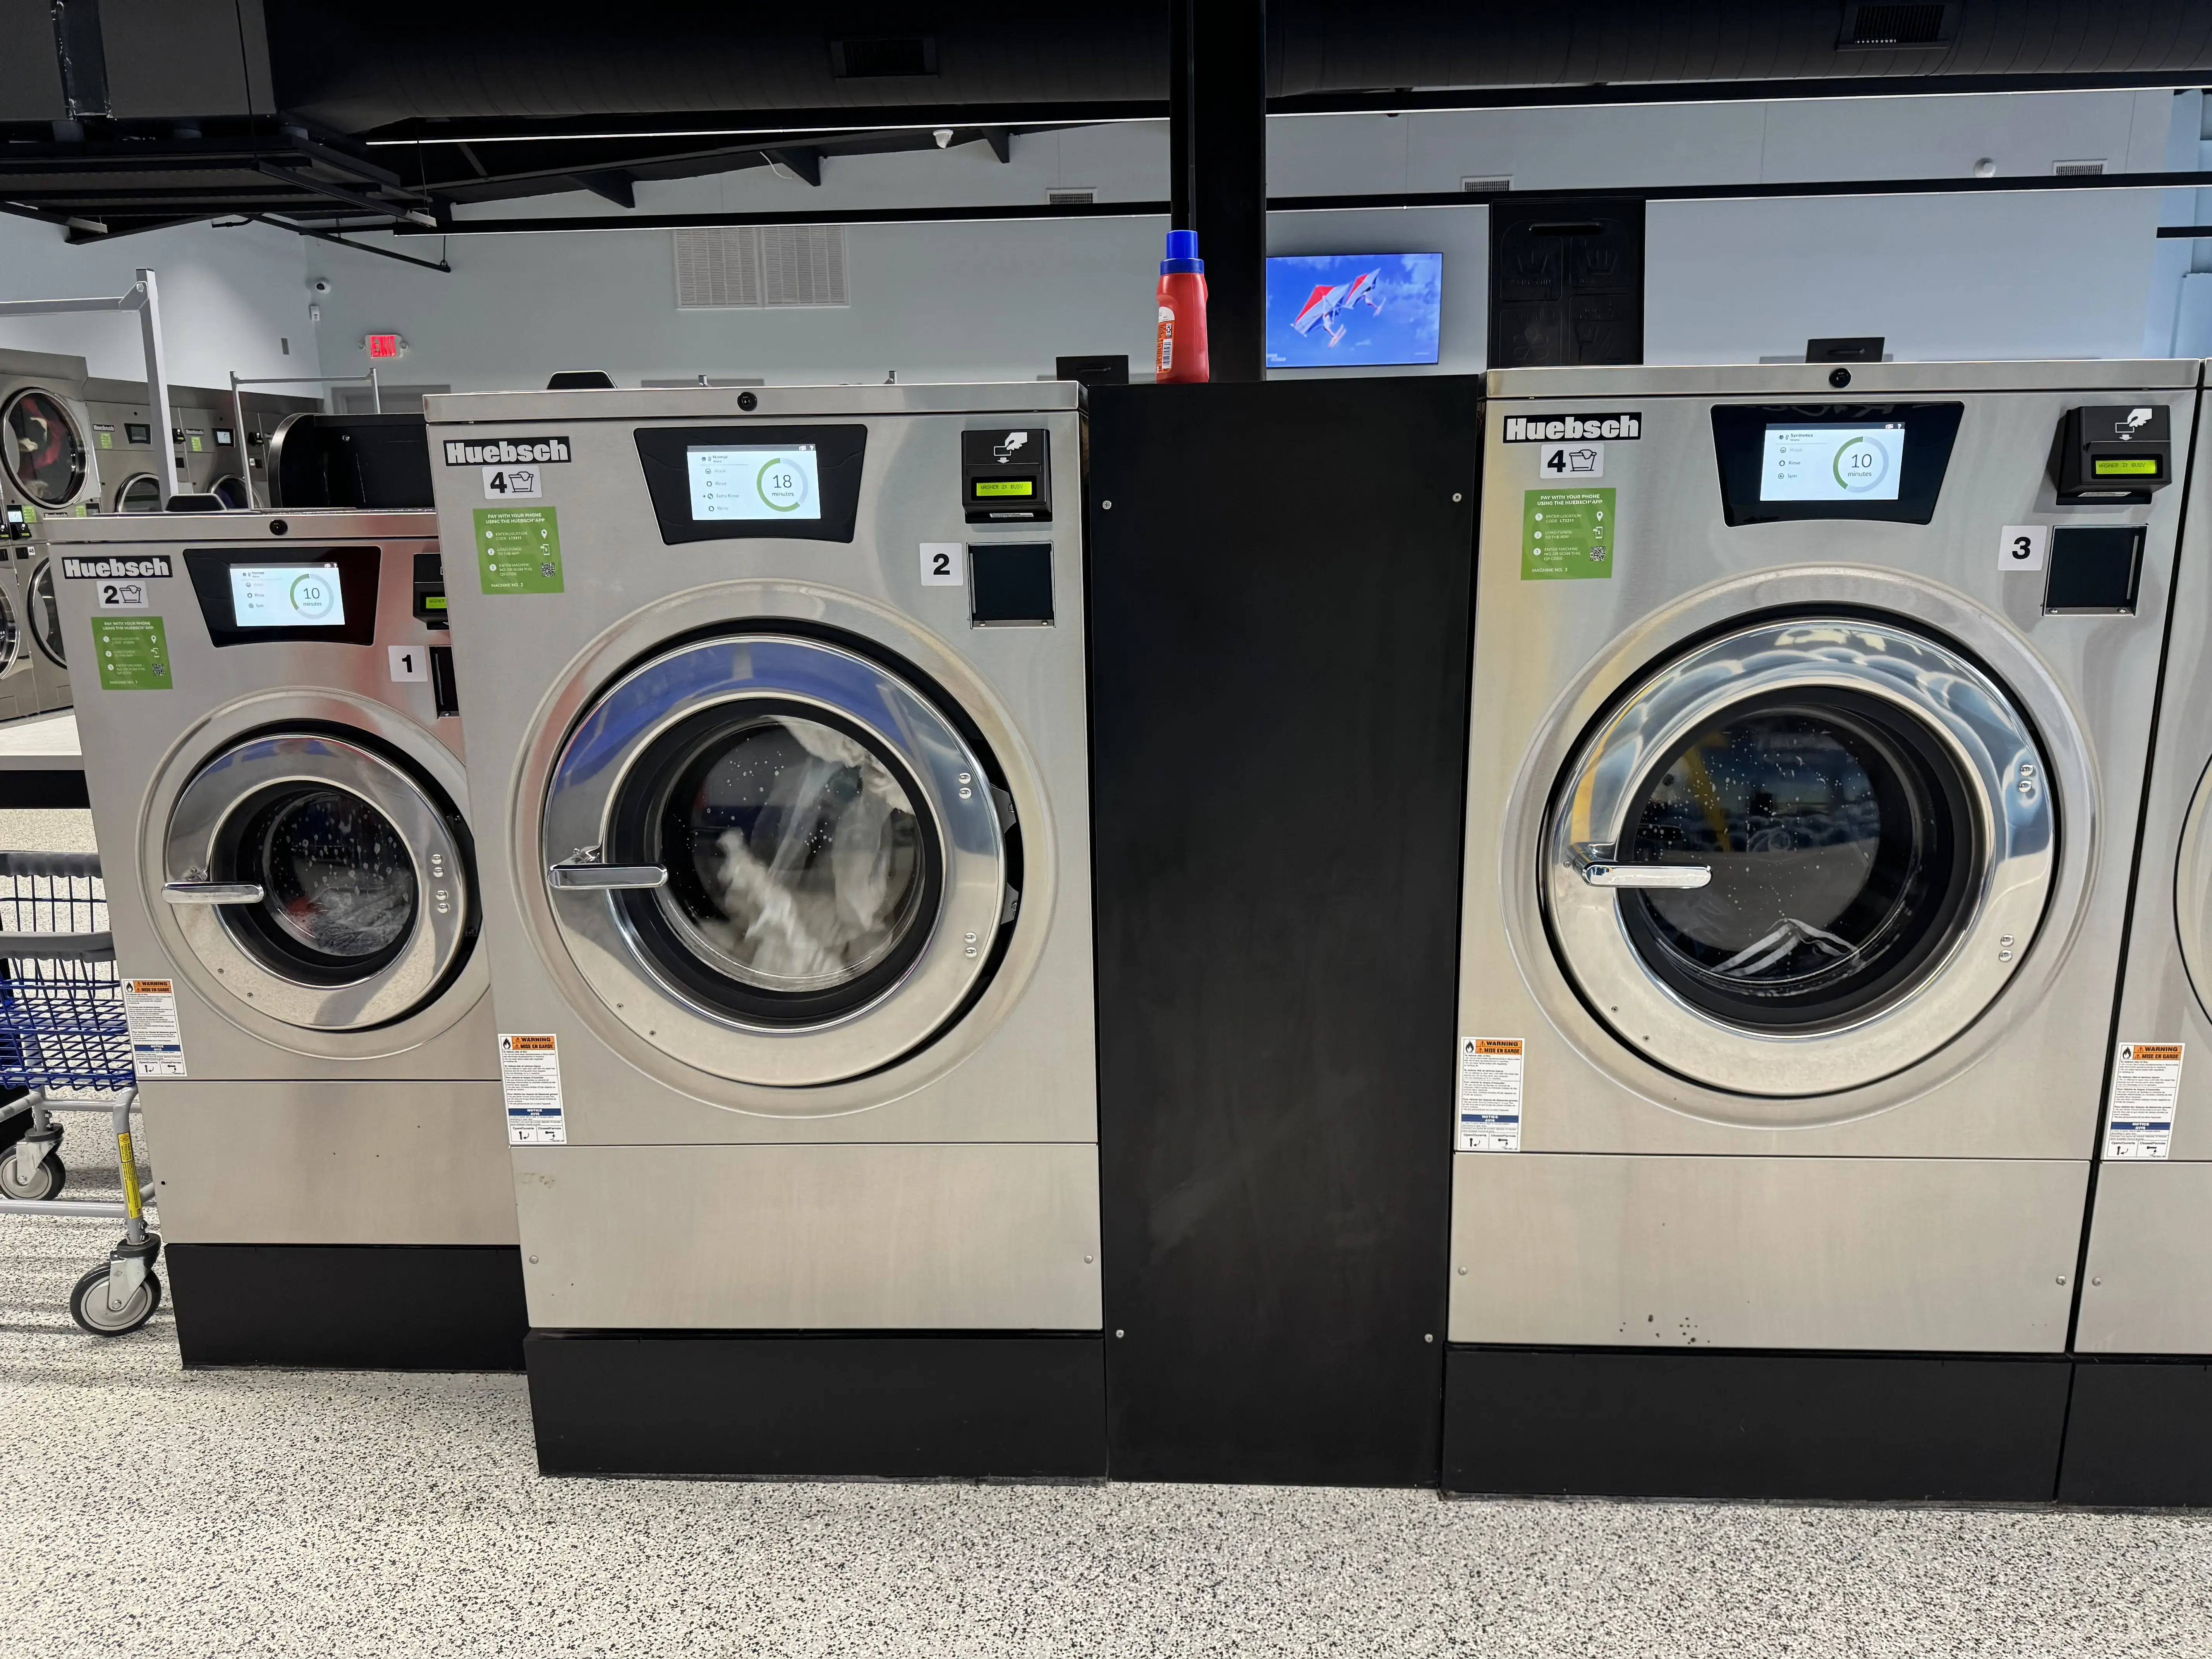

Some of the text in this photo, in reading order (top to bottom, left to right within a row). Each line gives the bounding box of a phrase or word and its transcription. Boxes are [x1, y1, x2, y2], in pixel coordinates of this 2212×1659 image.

[370, 335, 396, 357] EXIT
[1506, 415, 1638, 440] Huebsch
[446, 440, 568, 464] Huebsch
[1547, 450, 1566, 472] 4
[1851, 454, 1872, 468] 10
[490, 472, 507, 493] 4
[773, 475, 792, 488] 18
[2012, 536, 2031, 559] 3
[64, 558, 169, 577] Huebsch
[933, 553, 950, 575] 2
[103, 585, 119, 604] 2
[303, 588, 319, 599] 10
[402, 654, 412, 673] 1
